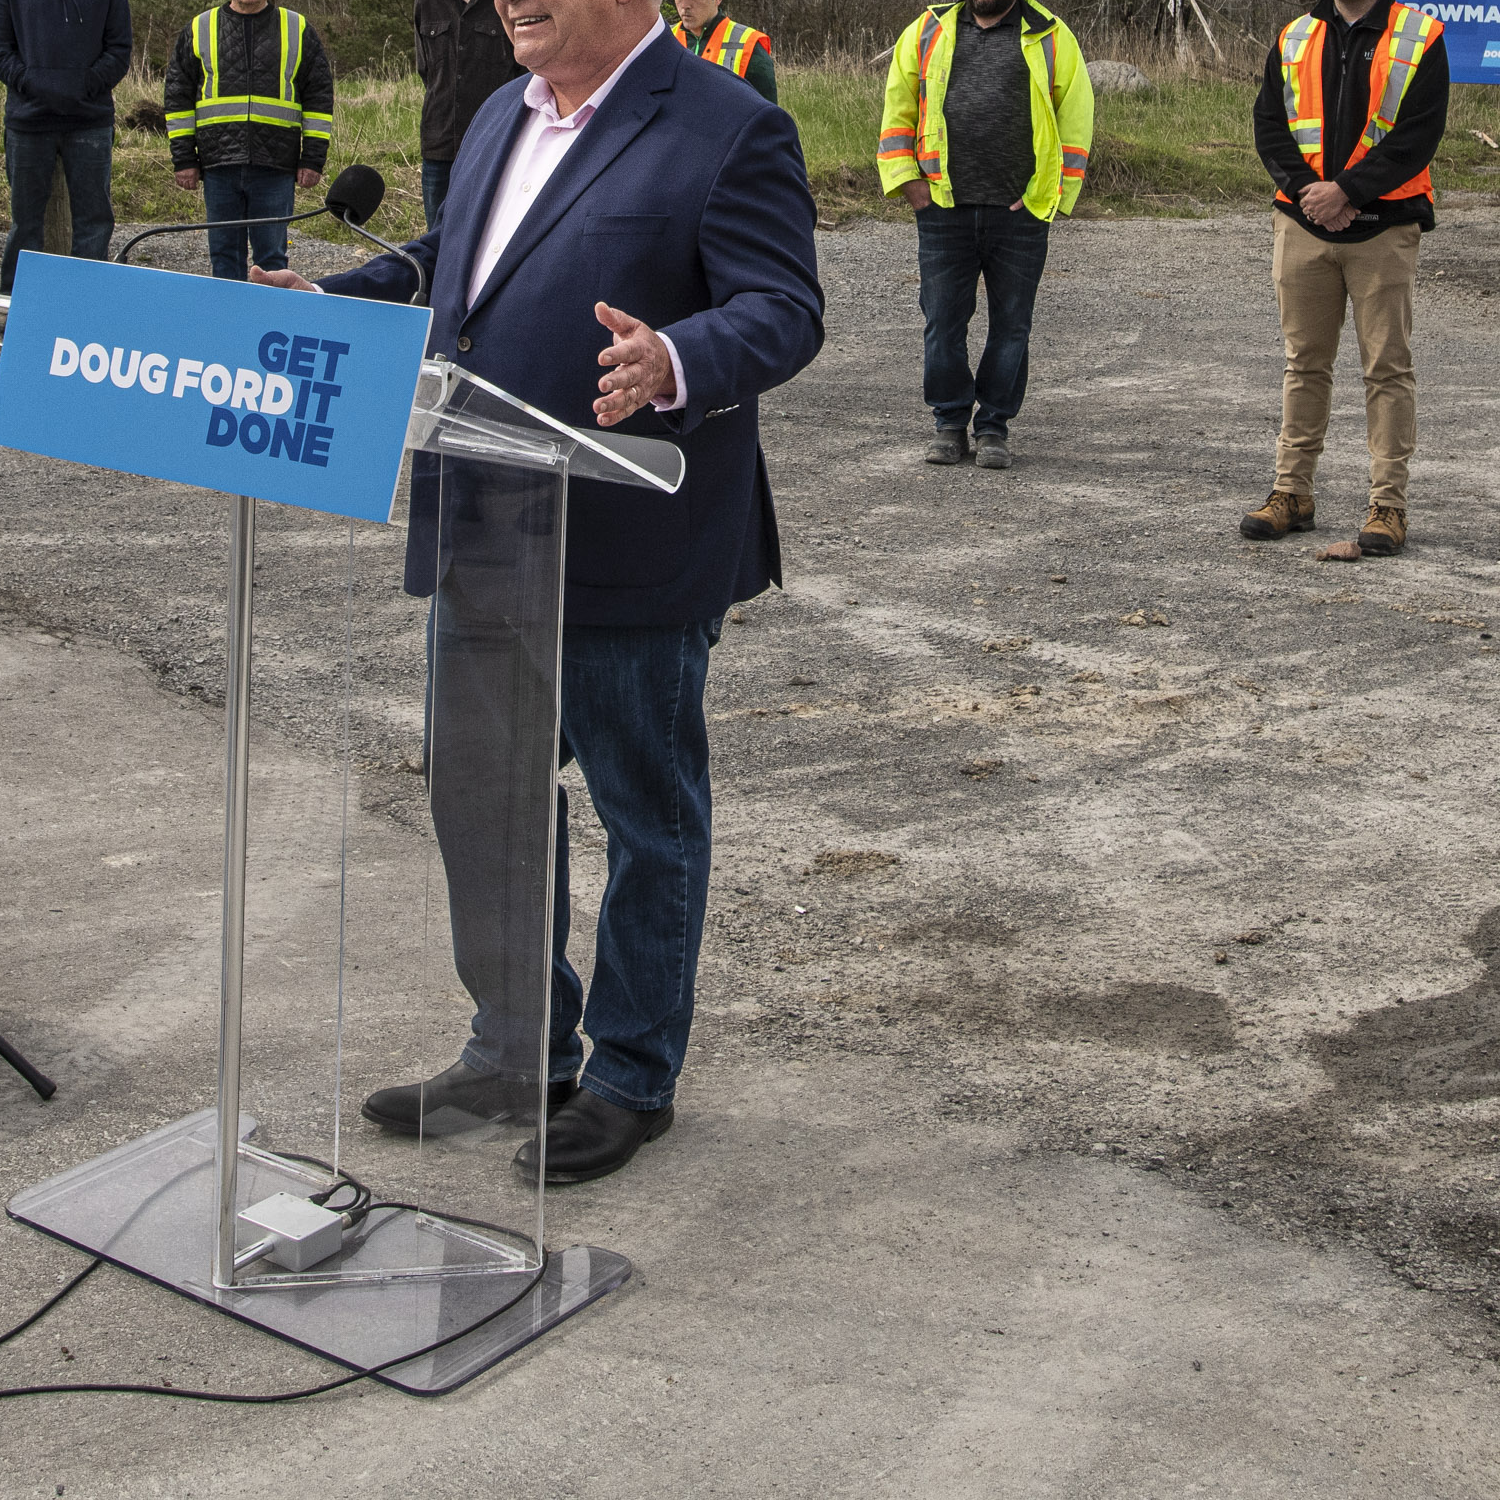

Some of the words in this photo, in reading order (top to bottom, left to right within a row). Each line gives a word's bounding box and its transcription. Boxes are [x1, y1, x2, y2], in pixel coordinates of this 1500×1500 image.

[49, 337, 168, 394] DOUG
[172, 358, 294, 416] FORD
[258, 330, 351, 382] GET
[294, 380, 342, 424] IT
[206, 406, 334, 468] DONE
